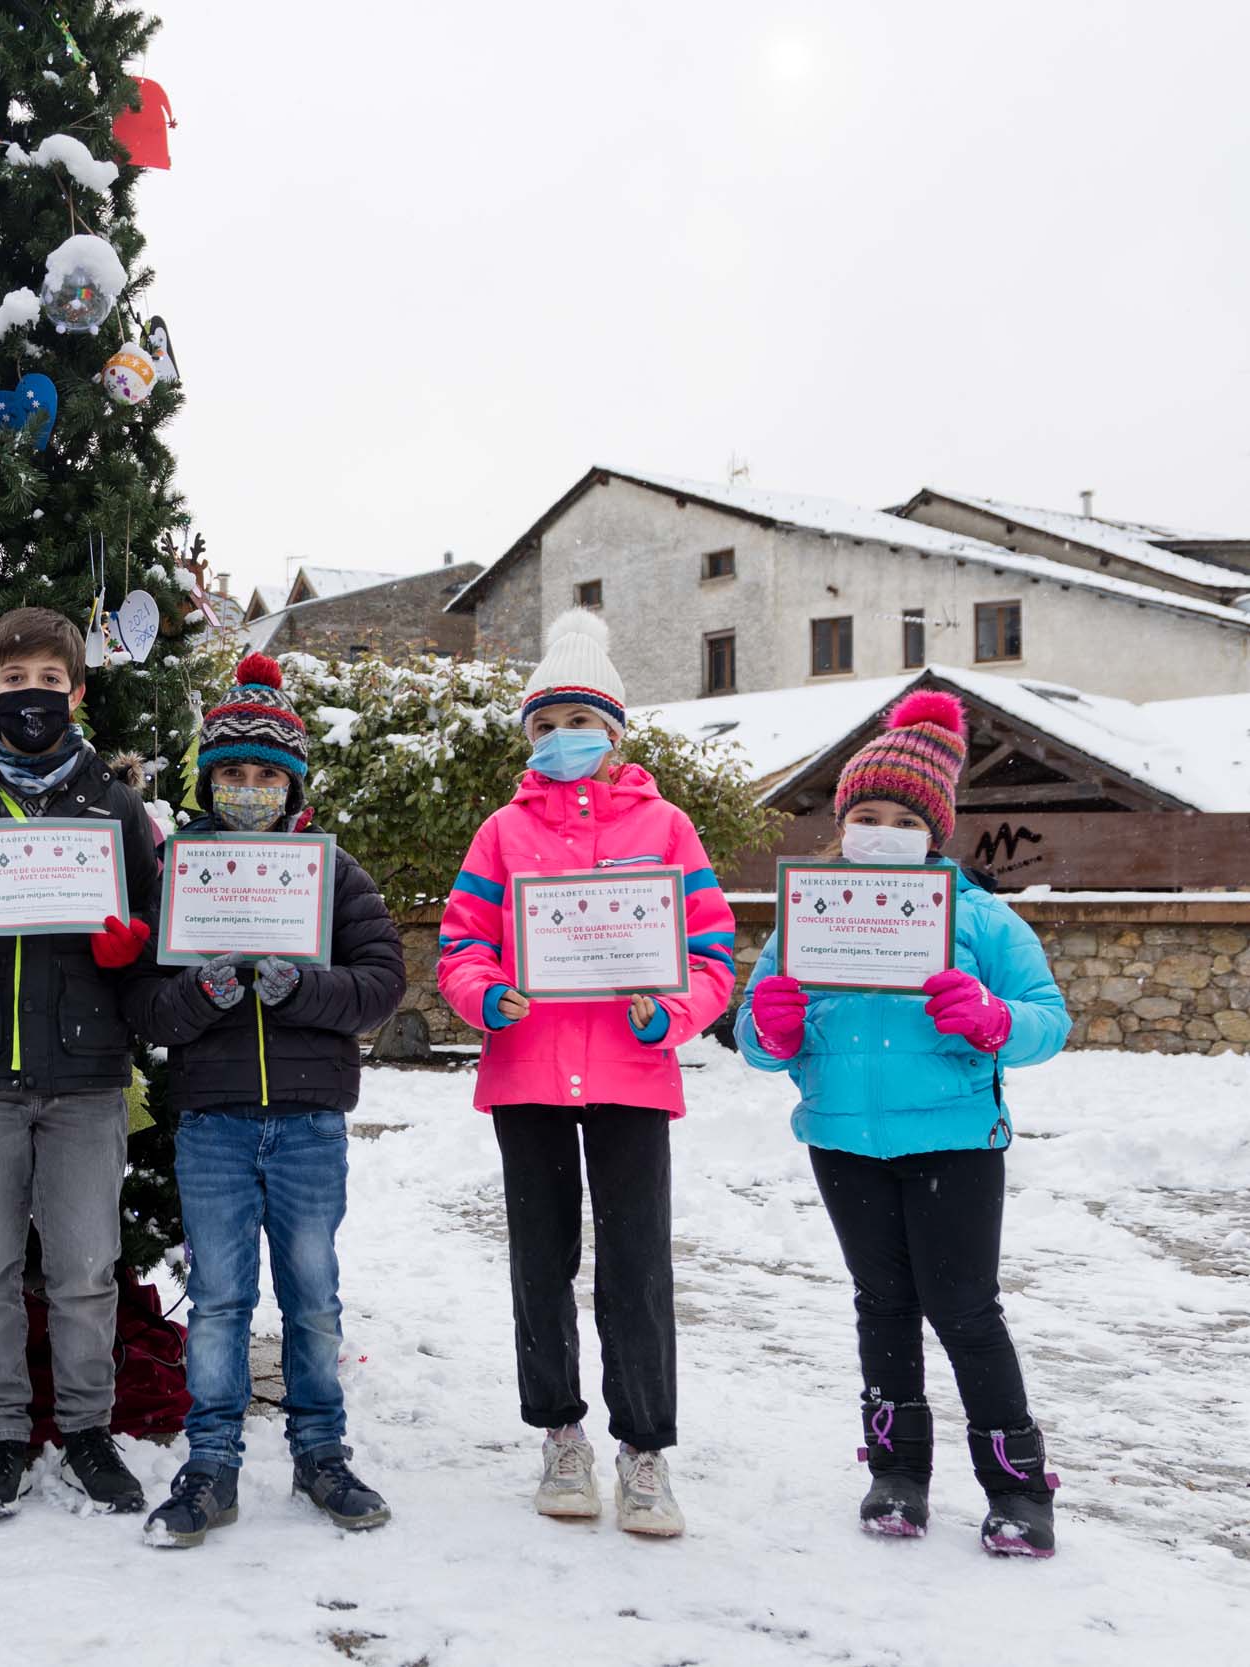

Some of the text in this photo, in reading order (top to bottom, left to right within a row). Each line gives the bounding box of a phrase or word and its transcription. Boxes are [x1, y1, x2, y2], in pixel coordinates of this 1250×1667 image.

[129, 602, 150, 632] 2021
[536, 890, 583, 898] MERCADET
[185, 915, 220, 925] Categoria
[848, 918, 910, 926] GUARNIMENTS
[585, 923, 642, 932] GUARNIMENTS
[801, 946, 838, 954] Categoria
[840, 946, 873, 956] mitjans.
[875, 948, 901, 956] Tercer
[544, 954, 581, 963] Categoria
[636, 951, 660, 960] premi
